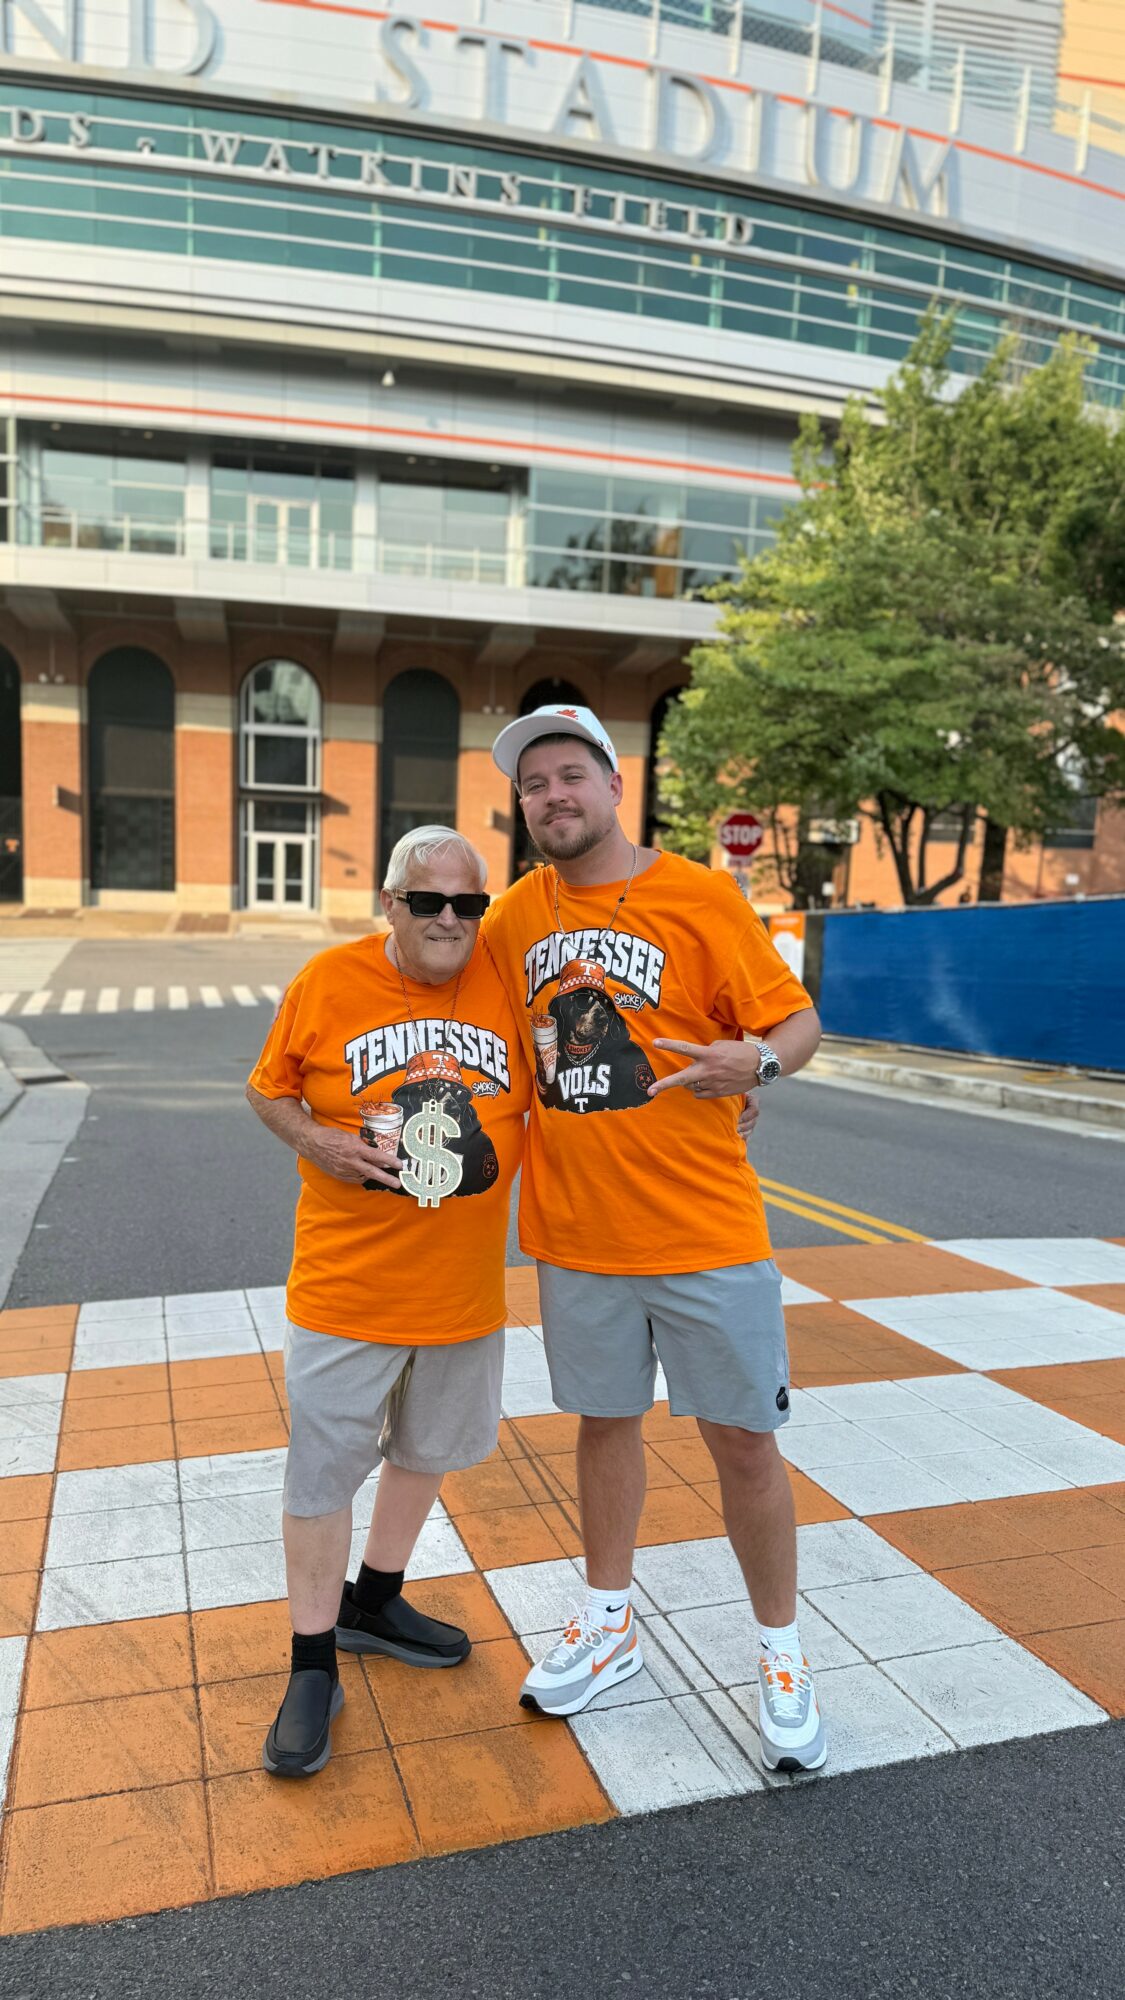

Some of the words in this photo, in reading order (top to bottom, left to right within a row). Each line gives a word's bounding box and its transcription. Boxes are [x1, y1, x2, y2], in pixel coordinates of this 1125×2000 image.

[378, 15, 950, 218] STADIUM
[10, 105, 91, 148] DS
[200, 127, 521, 206] WATKINS
[569, 183, 755, 246] FIELD
[721, 824, 763, 846] STOP
[524, 928, 666, 1009] TENNESSEE
[580, 962, 597, 976] T
[614, 992, 648, 1013] SMOKEY
[345, 1018, 510, 1096] TENNESSEE
[432, 1054, 449, 1067] T
[472, 1081, 501, 1098] SMOKEY
[557, 1063, 611, 1101] VOLS
[574, 1097, 589, 1114] T
